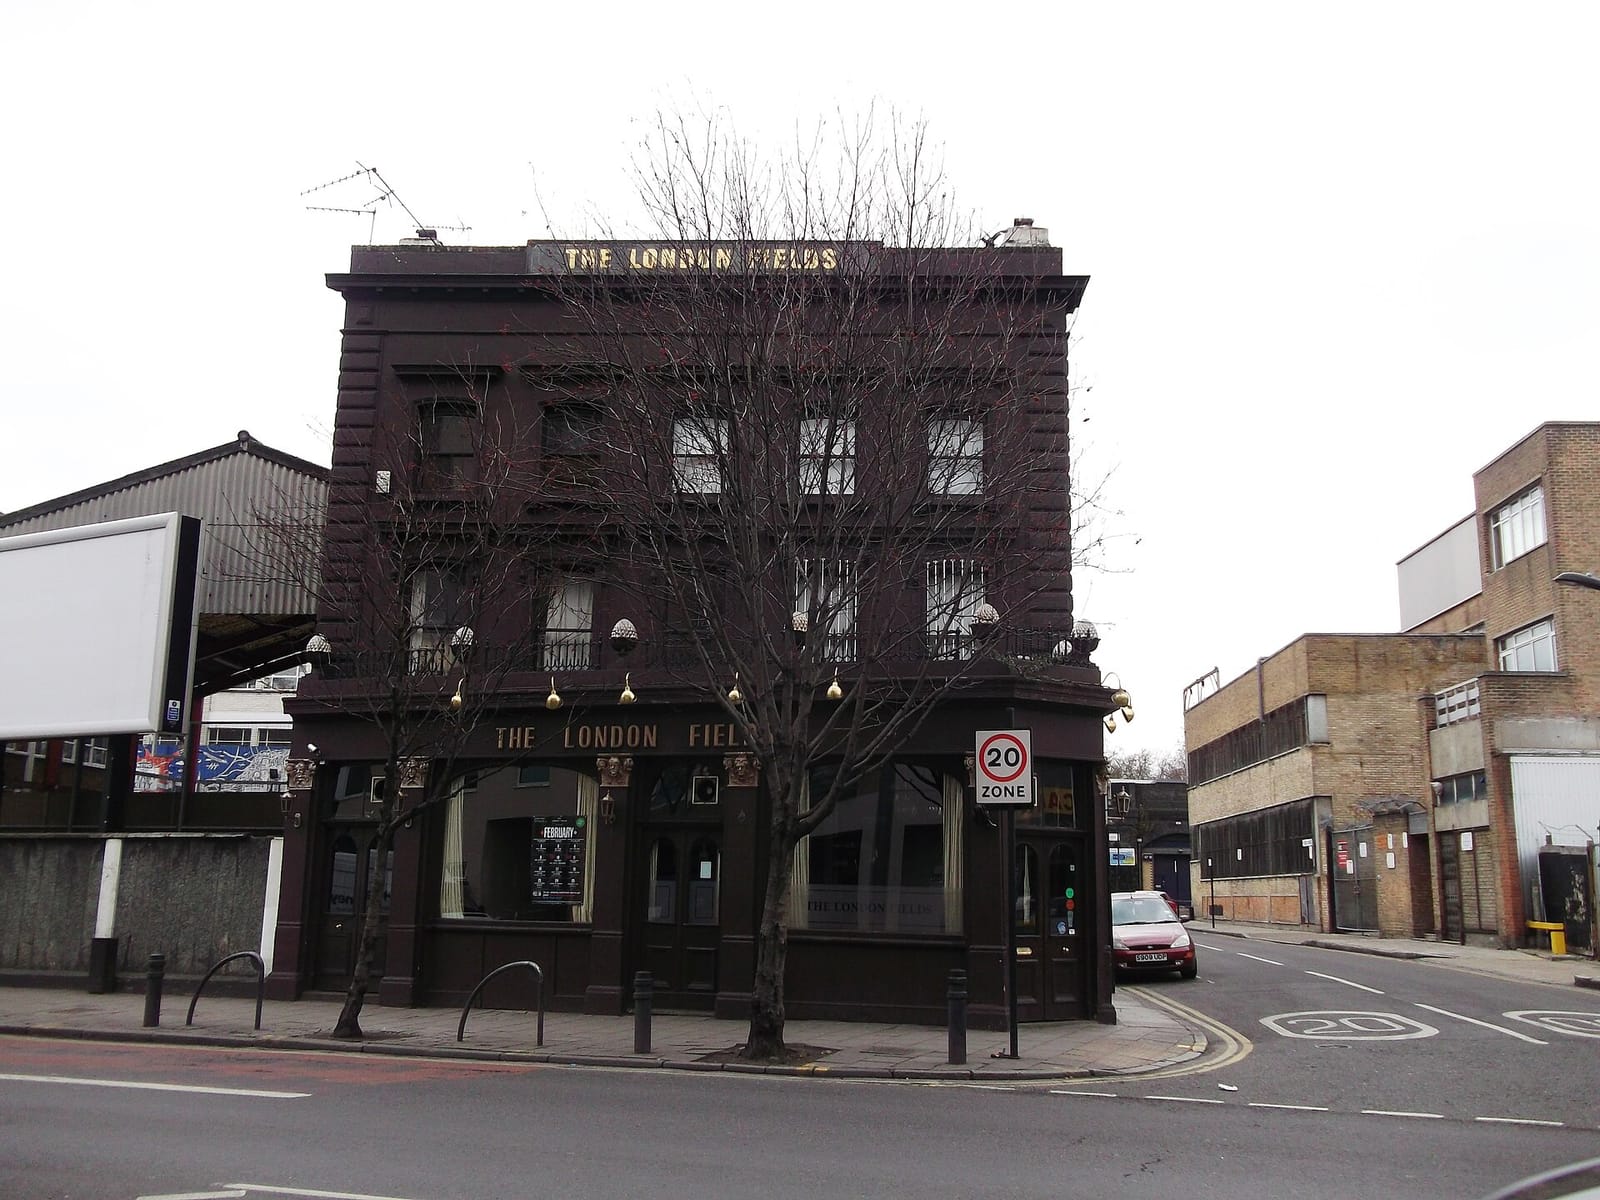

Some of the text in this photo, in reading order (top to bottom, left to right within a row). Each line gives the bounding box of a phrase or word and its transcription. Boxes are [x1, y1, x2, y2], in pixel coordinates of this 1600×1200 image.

[565, 248, 837, 269] THE LONDON FIELDS
[495, 723, 748, 749] THE LONDON FIEL
[987, 747, 1020, 767] 20
[982, 786, 1025, 798] ZONE
[544, 826, 575, 838] FEBRUARY
[808, 901, 831, 912] THE
[1287, 1016, 1406, 1035] 20
